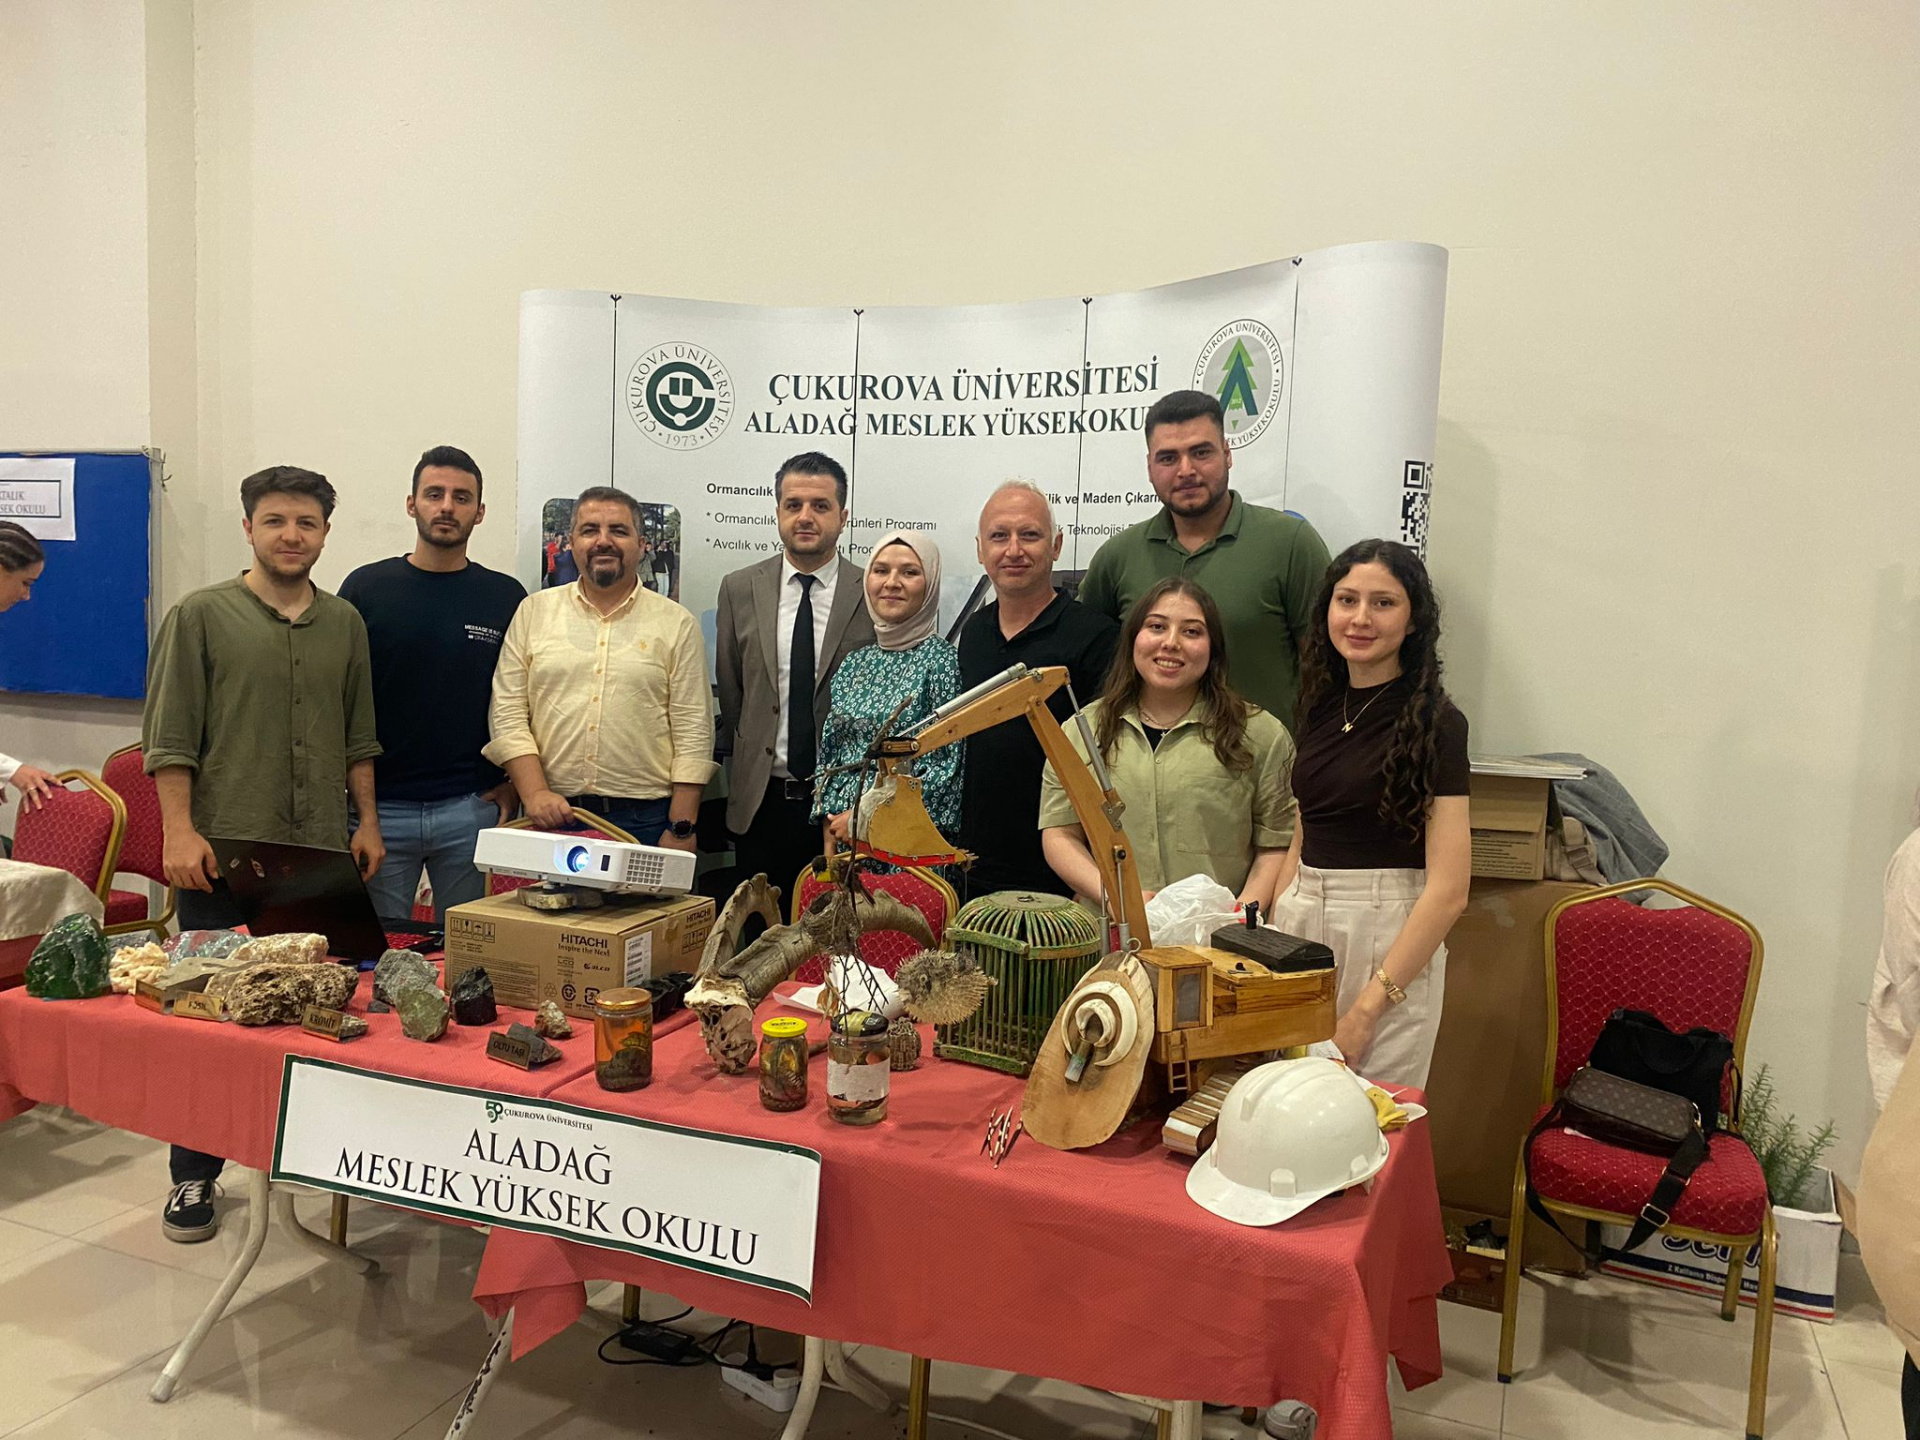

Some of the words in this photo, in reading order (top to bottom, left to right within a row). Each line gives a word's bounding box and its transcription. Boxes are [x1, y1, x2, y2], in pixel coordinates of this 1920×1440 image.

[1197, 327, 1234, 377] ÇUKUROVA
[769, 373, 944, 405] ÇUKUROVA
[952, 355, 1159, 401] ÜNİVERSİTESİ
[631, 350, 669, 433] ÇUKUROVA
[744, 407, 857, 436] ALADAĞ
[866, 413, 976, 437] MESLEK
[983, 406, 1153, 436] YÜKSEKOKU
[666, 434, 698, 447] 1973
[707, 483, 773, 497] Ormancılık
[1065, 496, 1078, 504] ve
[1083, 492, 1121, 504] Maden
[715, 512, 776, 526] Ormancılık
[713, 538, 751, 551] Avcılık
[755, 542, 768, 551] ve
[558, 943, 580, 952] Inspire
[594, 949, 610, 957] Next
[561, 933, 608, 949] HITACHI
[504, 1108, 545, 1121] ÇUKUROVA
[546, 1113, 593, 1131] ÜNİVERSİTESİ
[463, 1128, 613, 1185] ALADAĞ
[334, 1147, 464, 1202] MESLEK
[469, 1174, 613, 1234] YÜKSEK
[621, 1205, 760, 1266] OKULU
